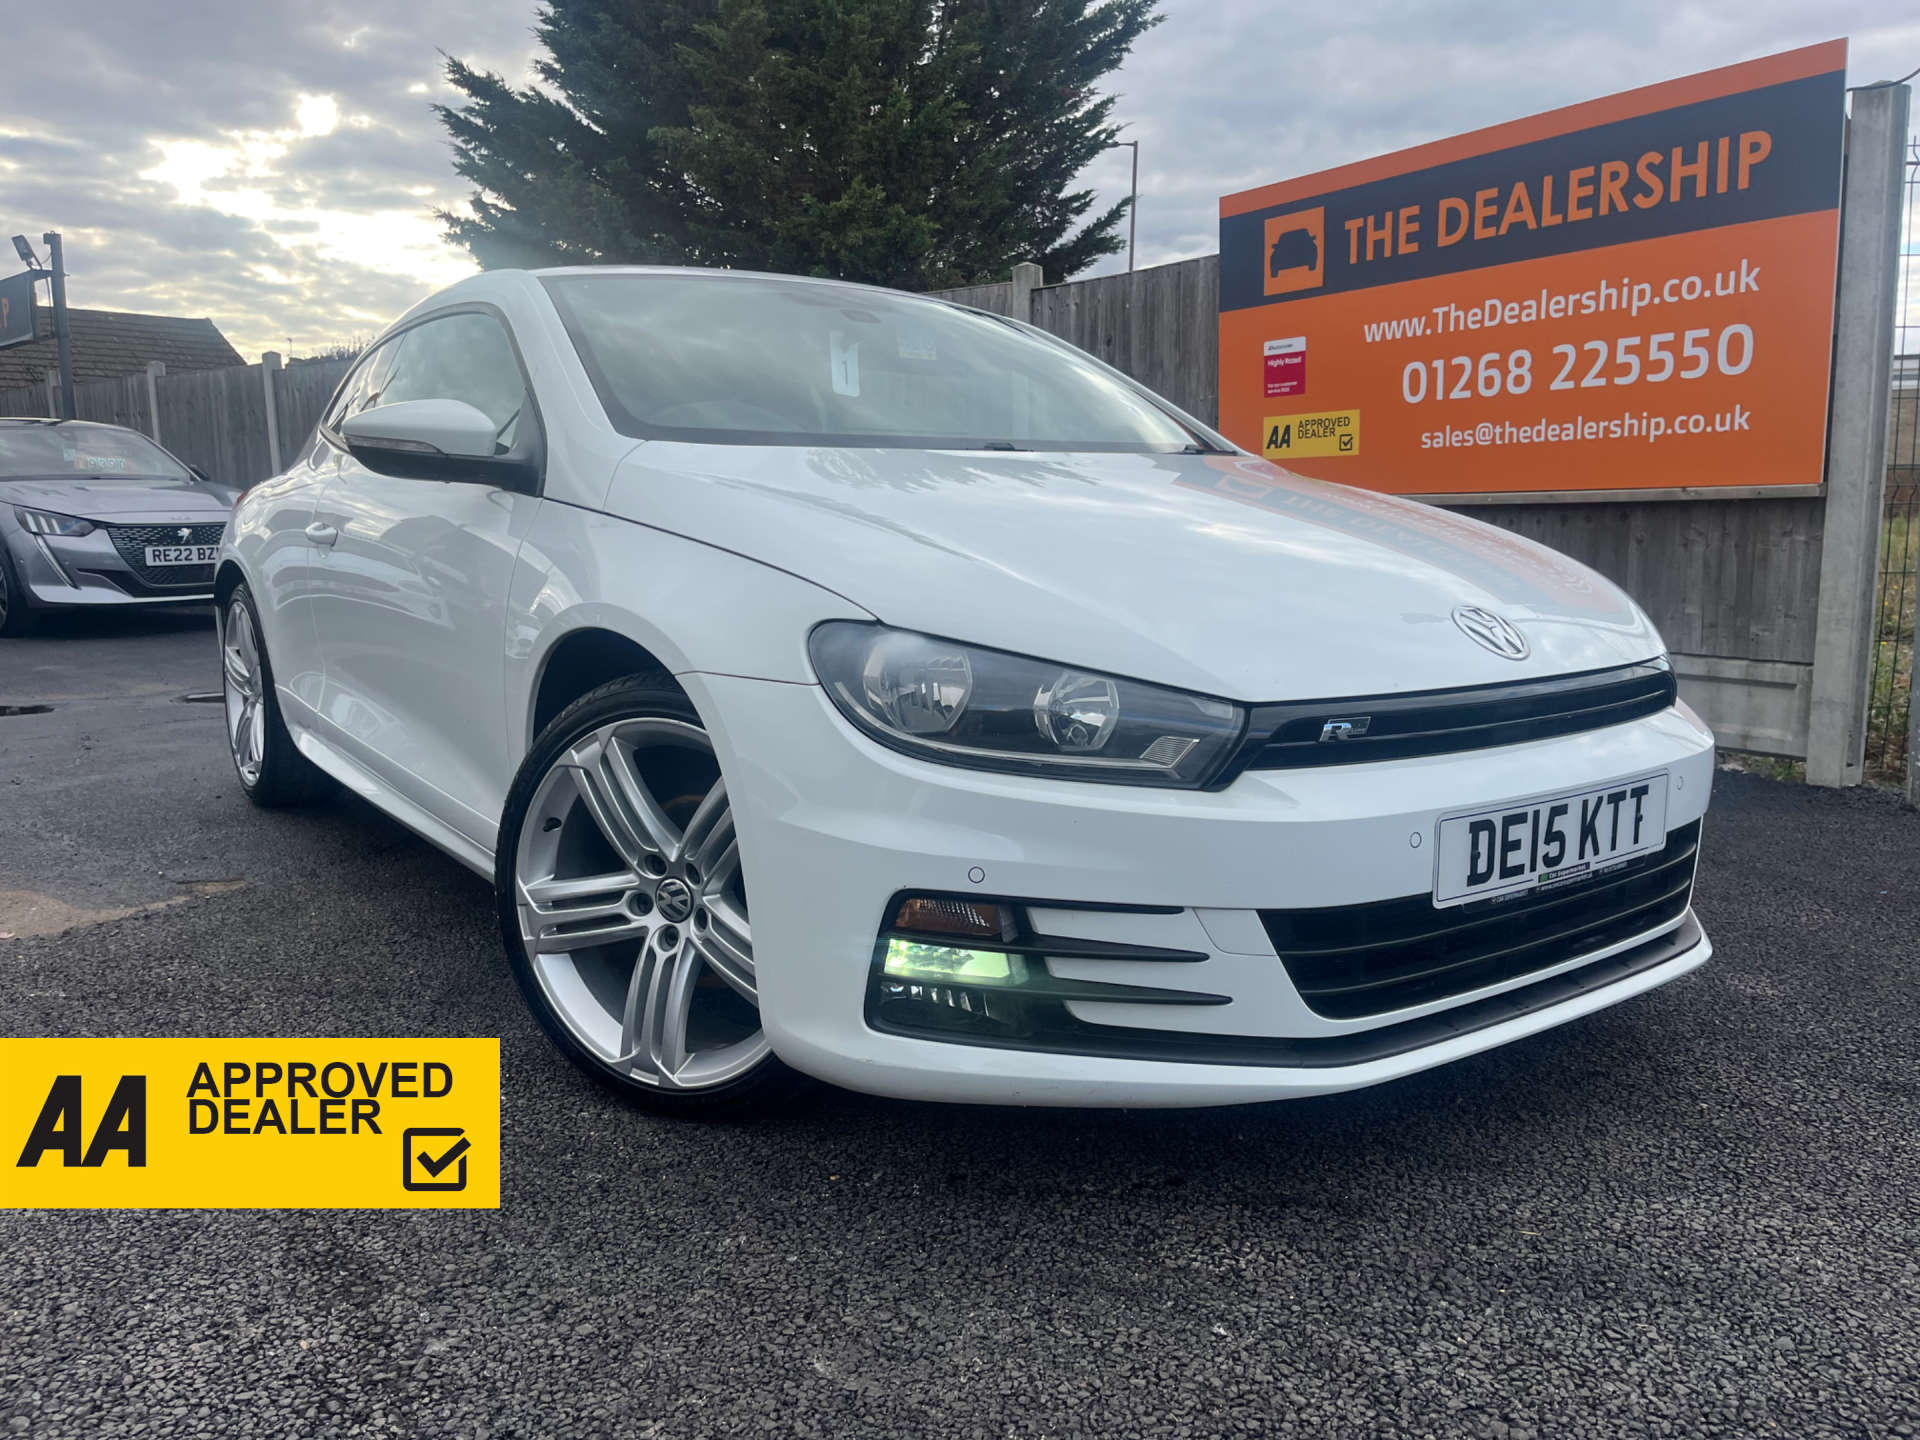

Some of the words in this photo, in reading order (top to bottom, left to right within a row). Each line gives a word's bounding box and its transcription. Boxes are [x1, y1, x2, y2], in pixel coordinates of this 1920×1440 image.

[1344, 204, 1420, 265] THE
[1437, 130, 1772, 248] DEALERSHIP
[1364, 258, 1760, 343] www.TheDealership.co.uk
[1402, 349, 1532, 404] 01268
[1549, 323, 1754, 391] 225550
[1266, 424, 1291, 450] AA
[1298, 416, 1351, 430] APPROVED
[1298, 427, 1336, 440] DEALER
[1421, 404, 1751, 449] sales@thedealership.co.uk
[152, 547, 193, 562] RE22
[1467, 803, 1568, 887] DE15
[1578, 783, 1649, 861] KTT
